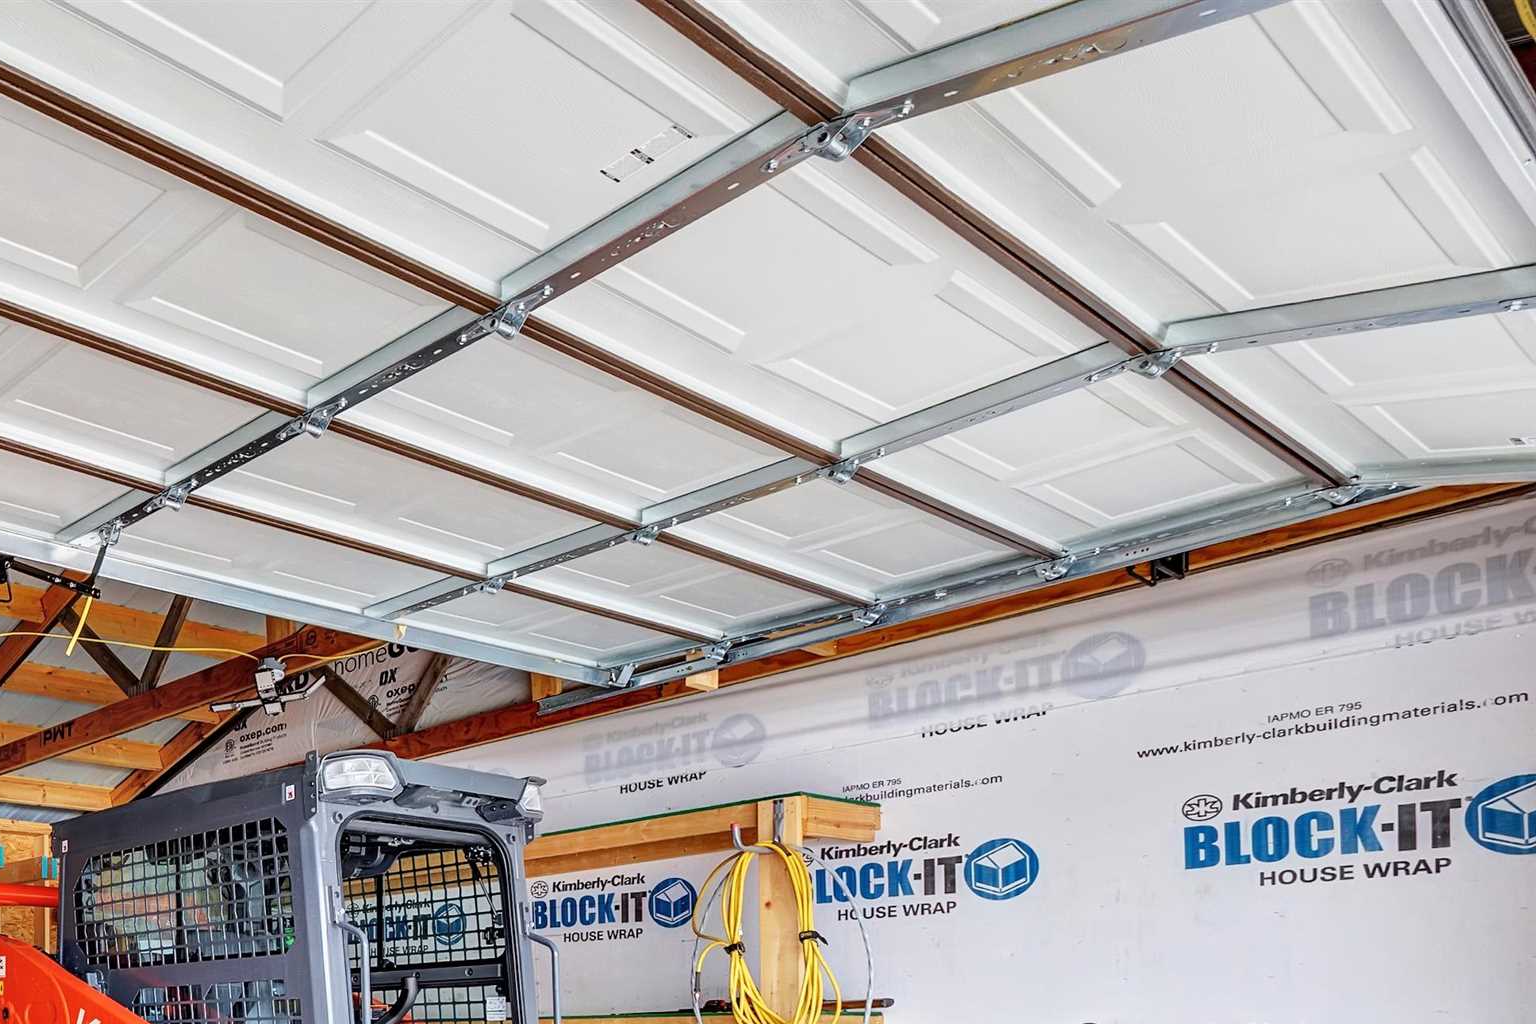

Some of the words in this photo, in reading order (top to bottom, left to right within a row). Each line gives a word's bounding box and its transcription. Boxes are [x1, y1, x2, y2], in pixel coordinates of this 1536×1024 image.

[1136, 690, 1529, 758] www.kimberly-clarkbuildingmaterials.om
[1267, 710, 1311, 724] IAPMO
[1314, 705, 1335, 718] ER
[1337, 701, 1363, 714] 795
[619, 777, 664, 795] HOUSE
[667, 770, 707, 786] WRAP
[872, 779, 884, 790] ER
[886, 777, 902, 788] 795
[1232, 769, 1459, 812] Kimberly-Clark
[820, 833, 961, 862] Kimberly-Clark
[1183, 797, 1462, 871] BLOCK-IT
[552, 873, 646, 894] Kimberly-Clark
[812, 855, 963, 904] LOCK-IT
[1259, 864, 1355, 887] HOUSE
[1362, 857, 1452, 881] WRAP
[532, 890, 648, 930] BLOCK-IT
[837, 905, 898, 921] HOUSE
[902, 901, 957, 918] WRAP
[563, 931, 604, 943] HOUSE
[607, 927, 644, 940] WRAP
